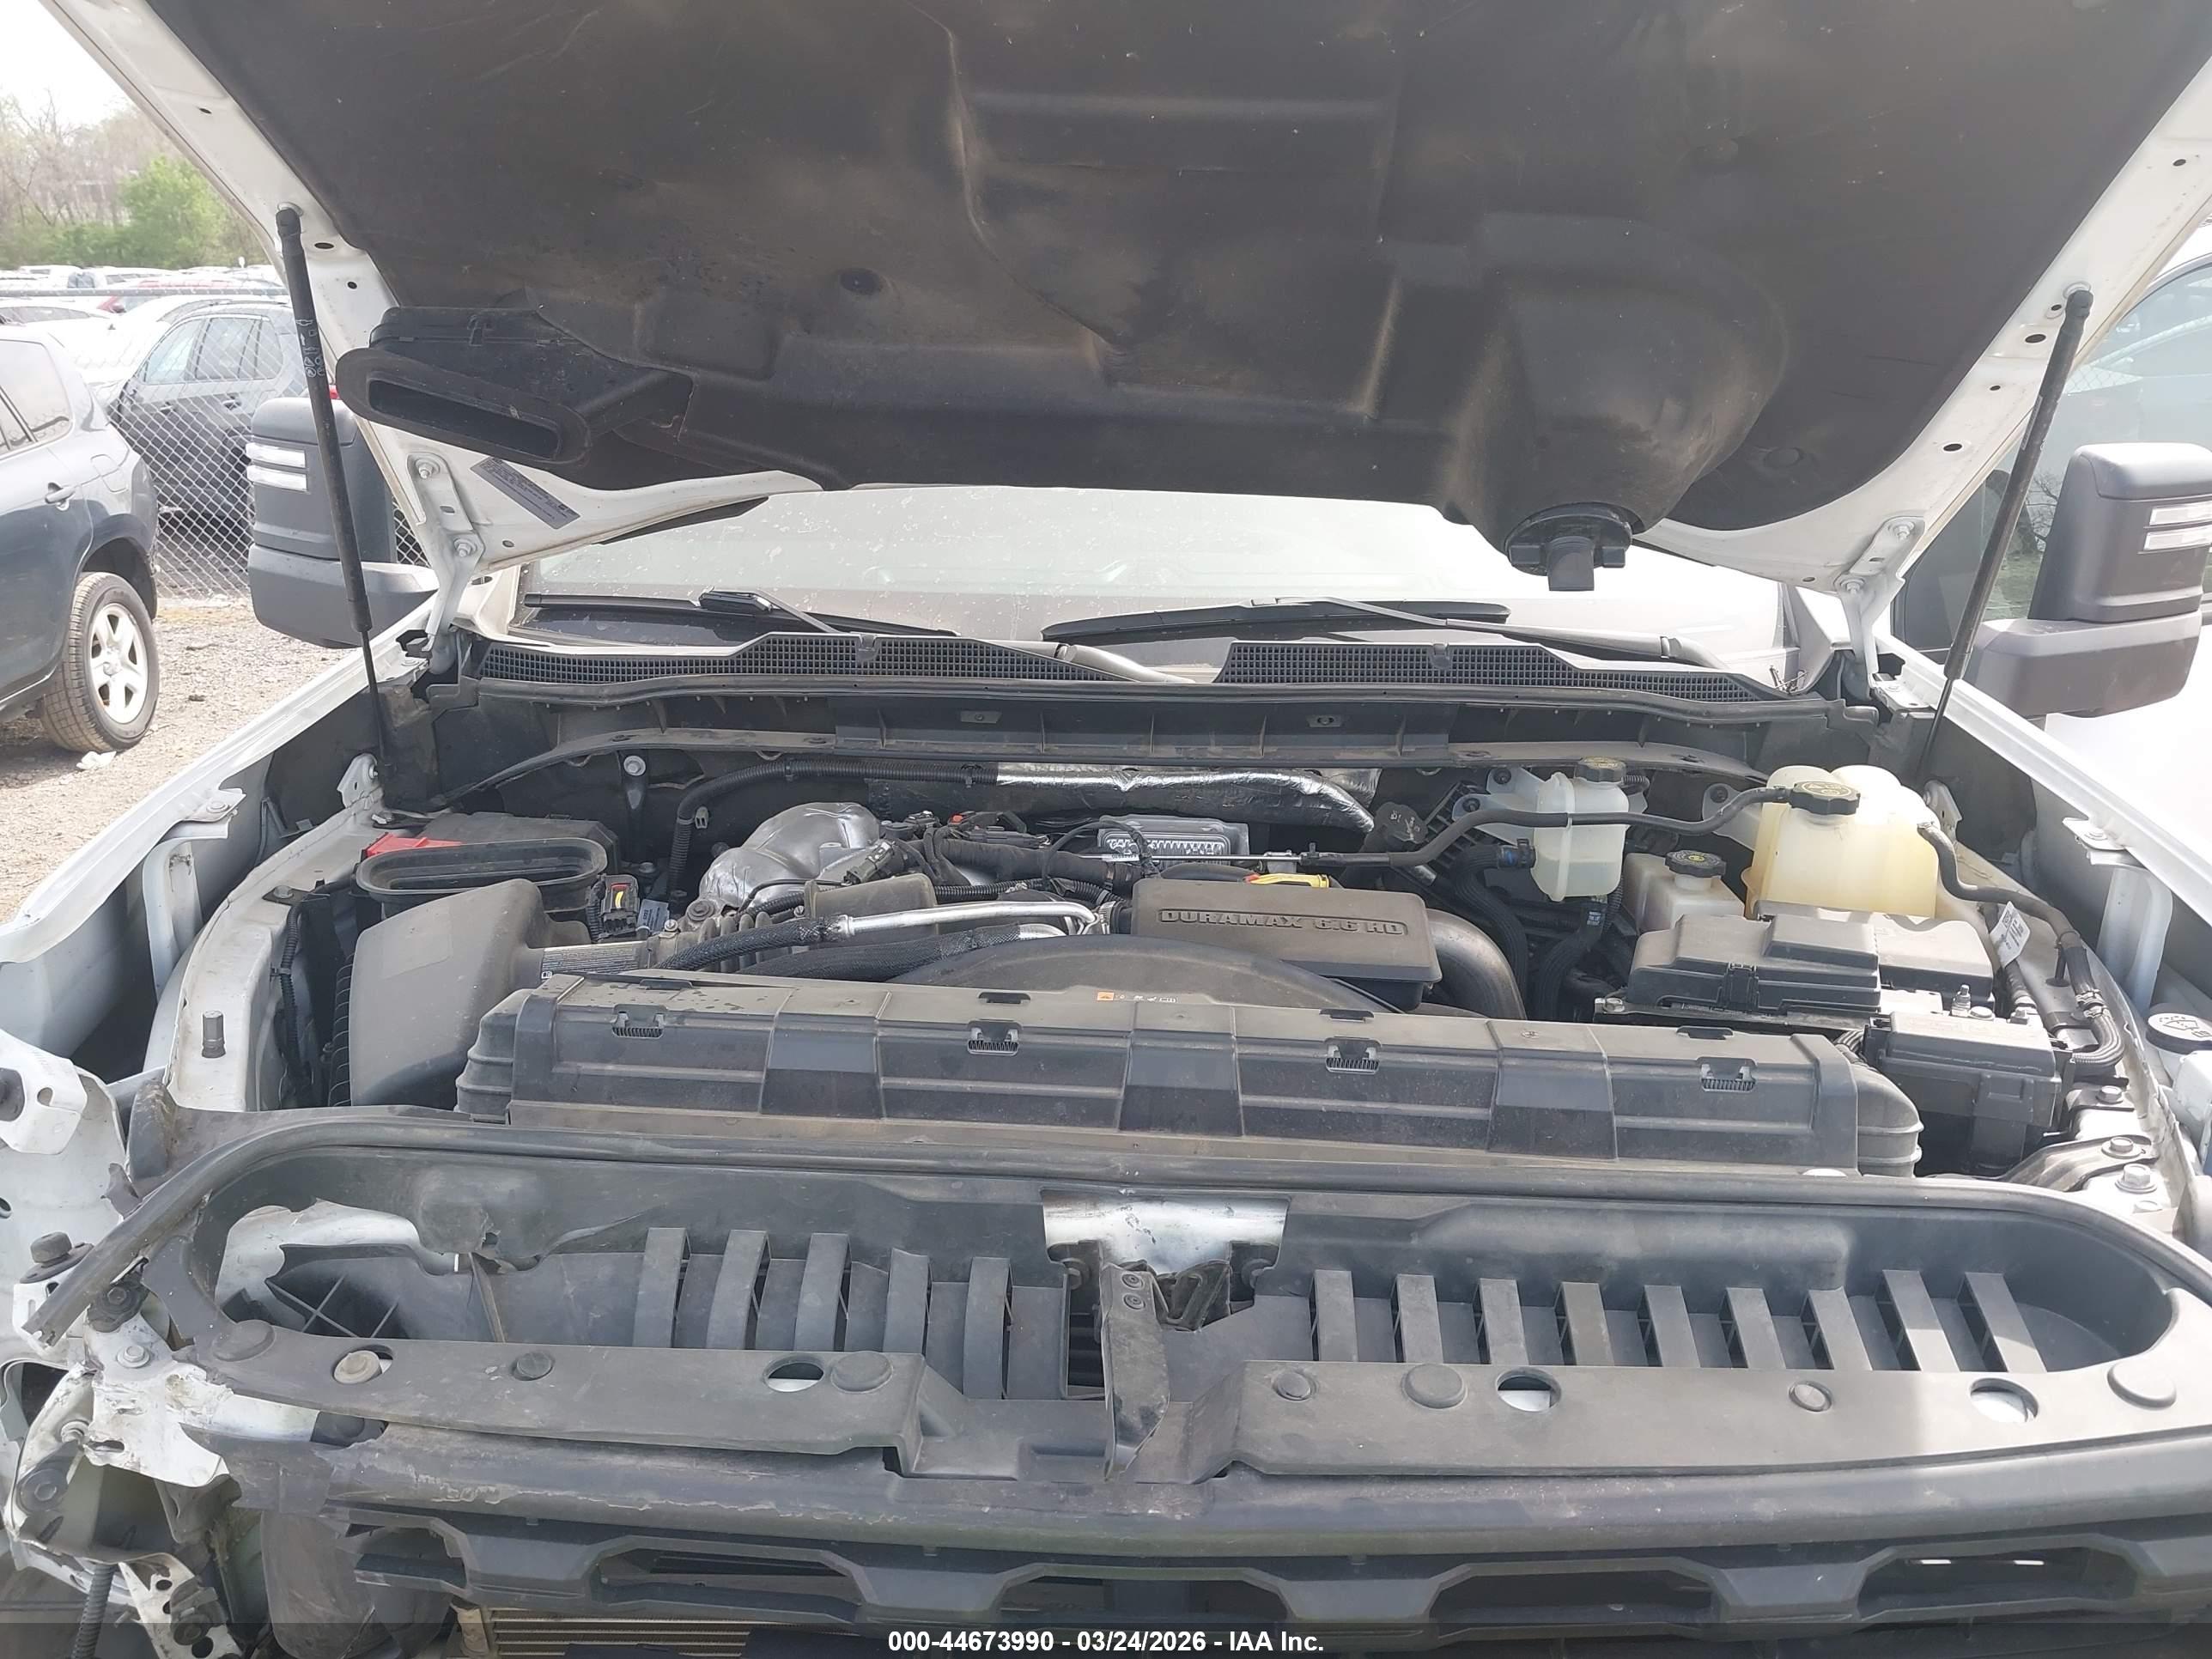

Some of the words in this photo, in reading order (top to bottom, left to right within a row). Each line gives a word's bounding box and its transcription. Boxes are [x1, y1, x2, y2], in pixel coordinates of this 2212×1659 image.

[1160, 910, 1303, 928] DURAMAX
[1314, 919, 1358, 933] 6.6
[1366, 921, 1404, 935] HD
